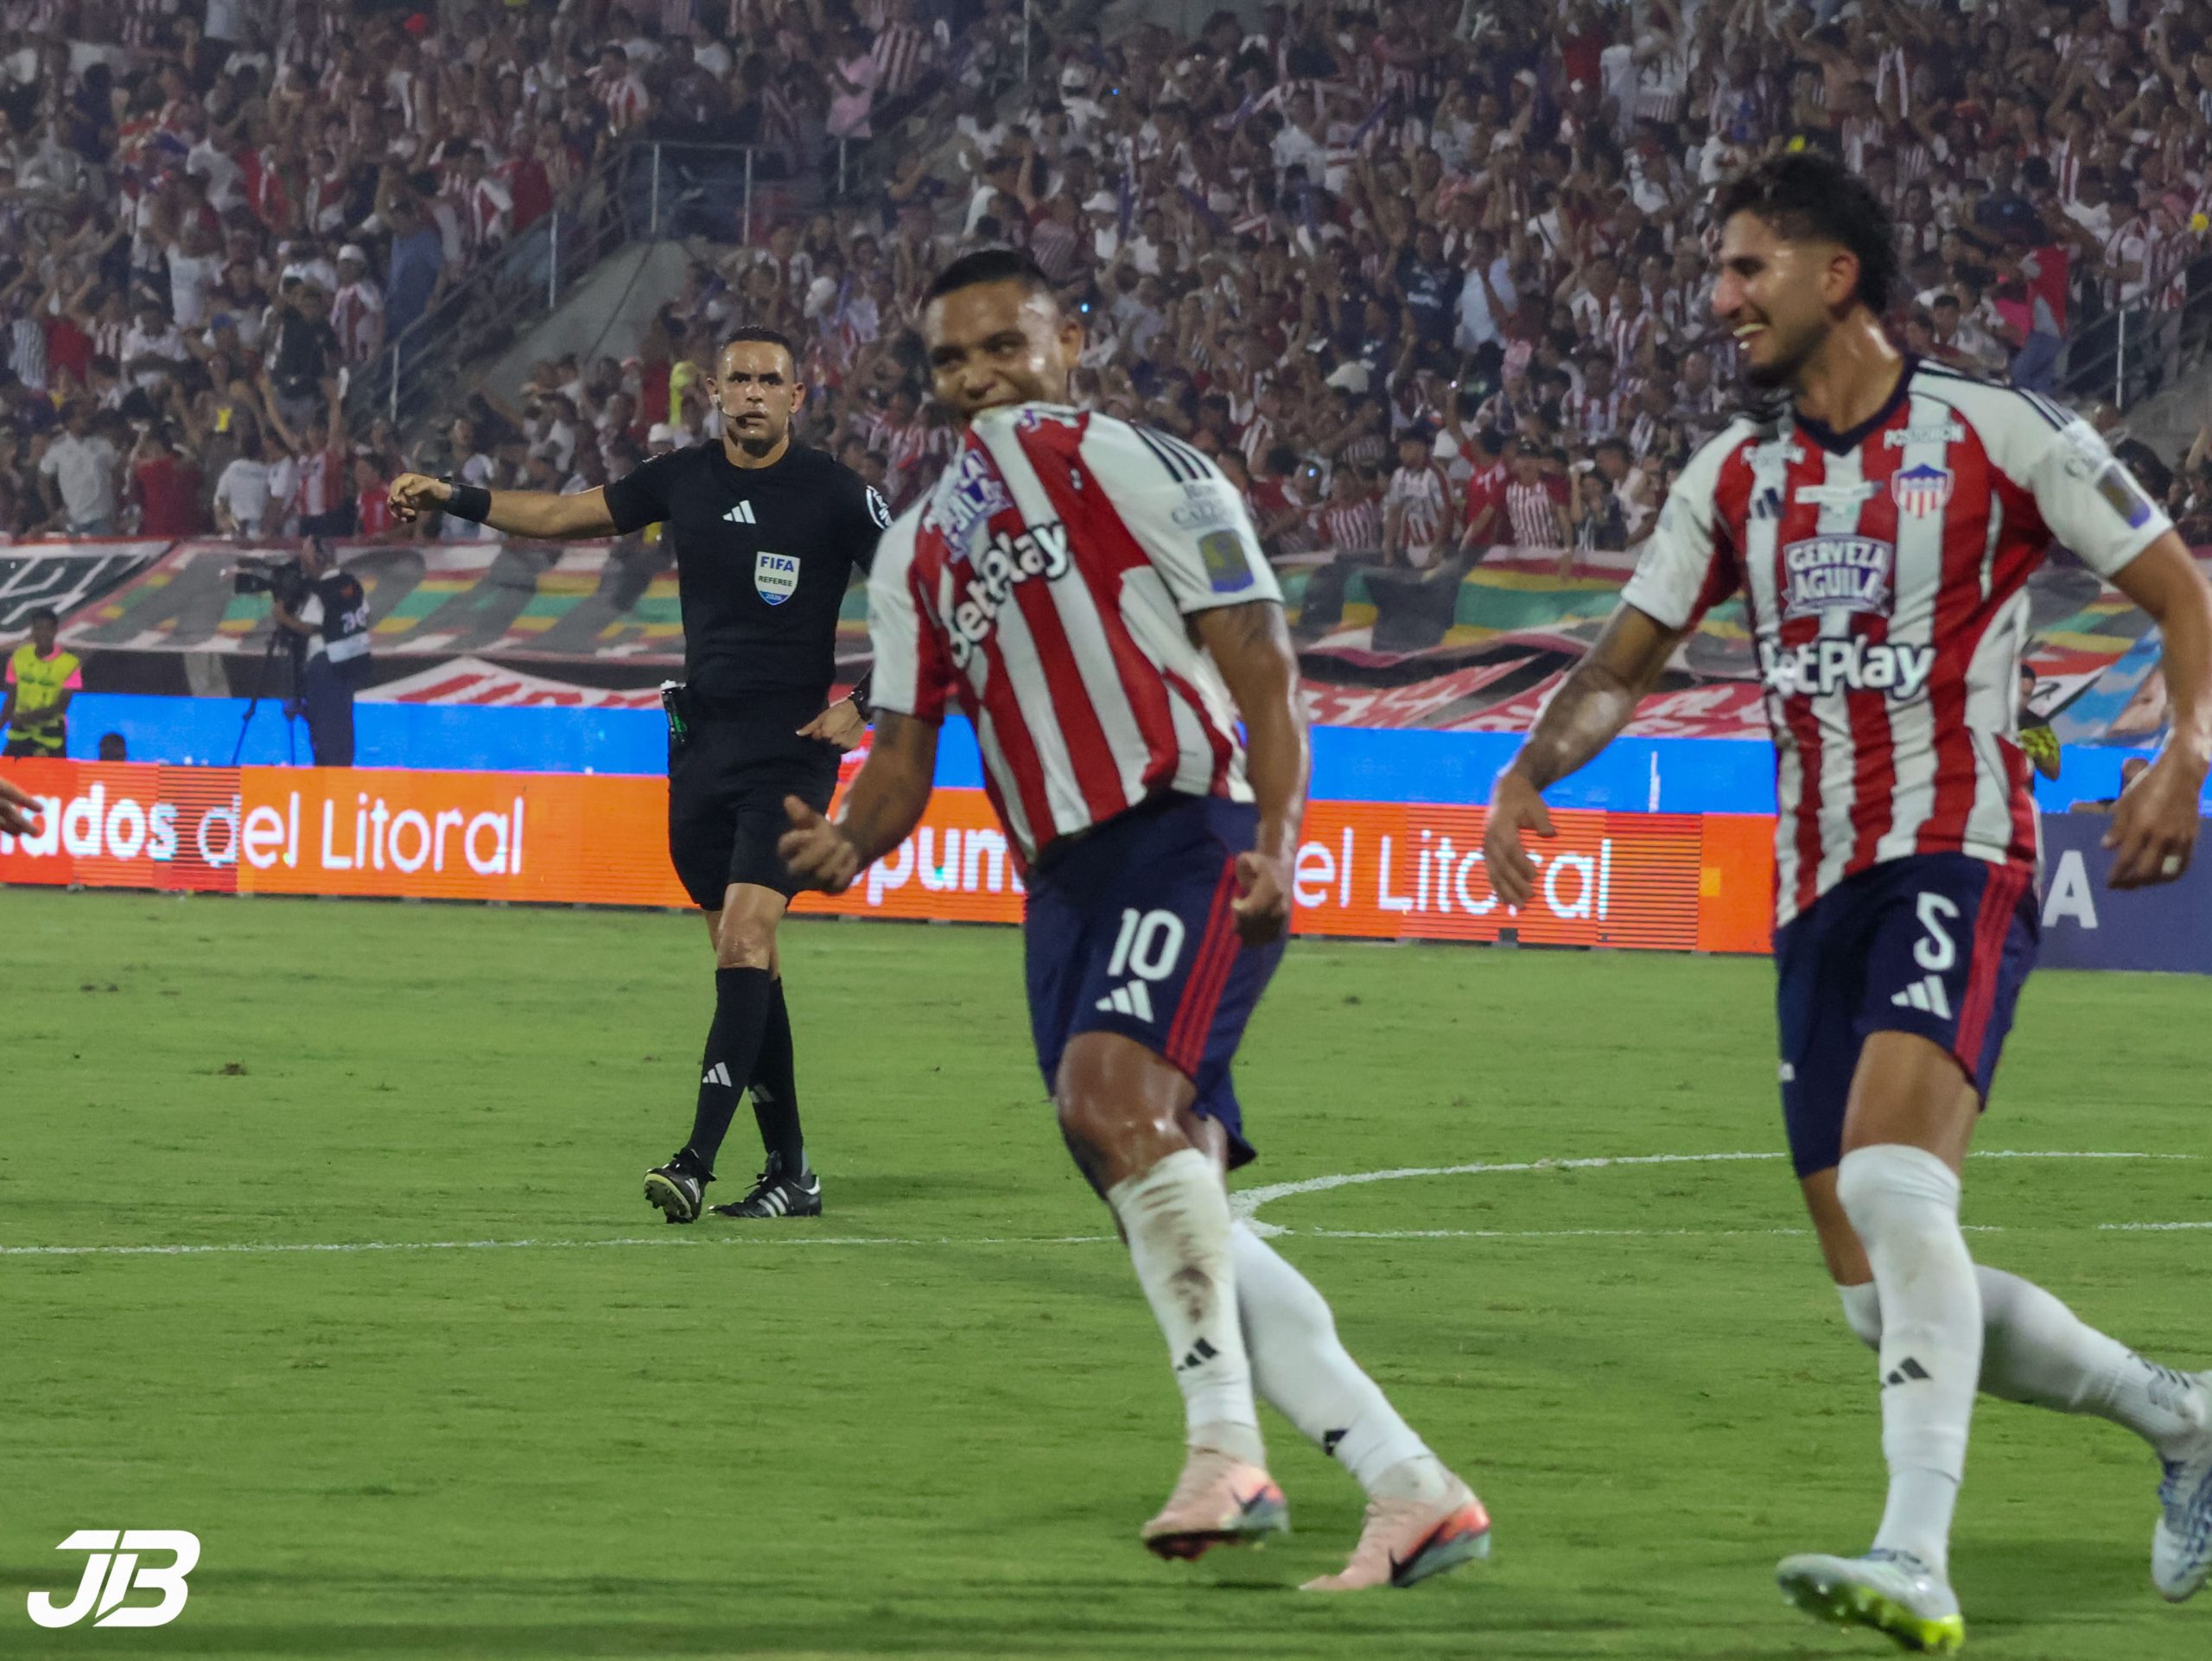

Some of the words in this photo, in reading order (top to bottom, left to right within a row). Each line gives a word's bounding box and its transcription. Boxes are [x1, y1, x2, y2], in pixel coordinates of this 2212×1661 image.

[758, 575, 793, 587] REFEREE
[760, 556, 795, 572] FIFA
[0, 781, 179, 862] ados
[197, 791, 300, 869] del
[321, 792, 524, 875] Litoral
[1293, 826, 1354, 908] el
[1378, 829, 1612, 922] Litoal
[1107, 907, 1185, 981] 10
